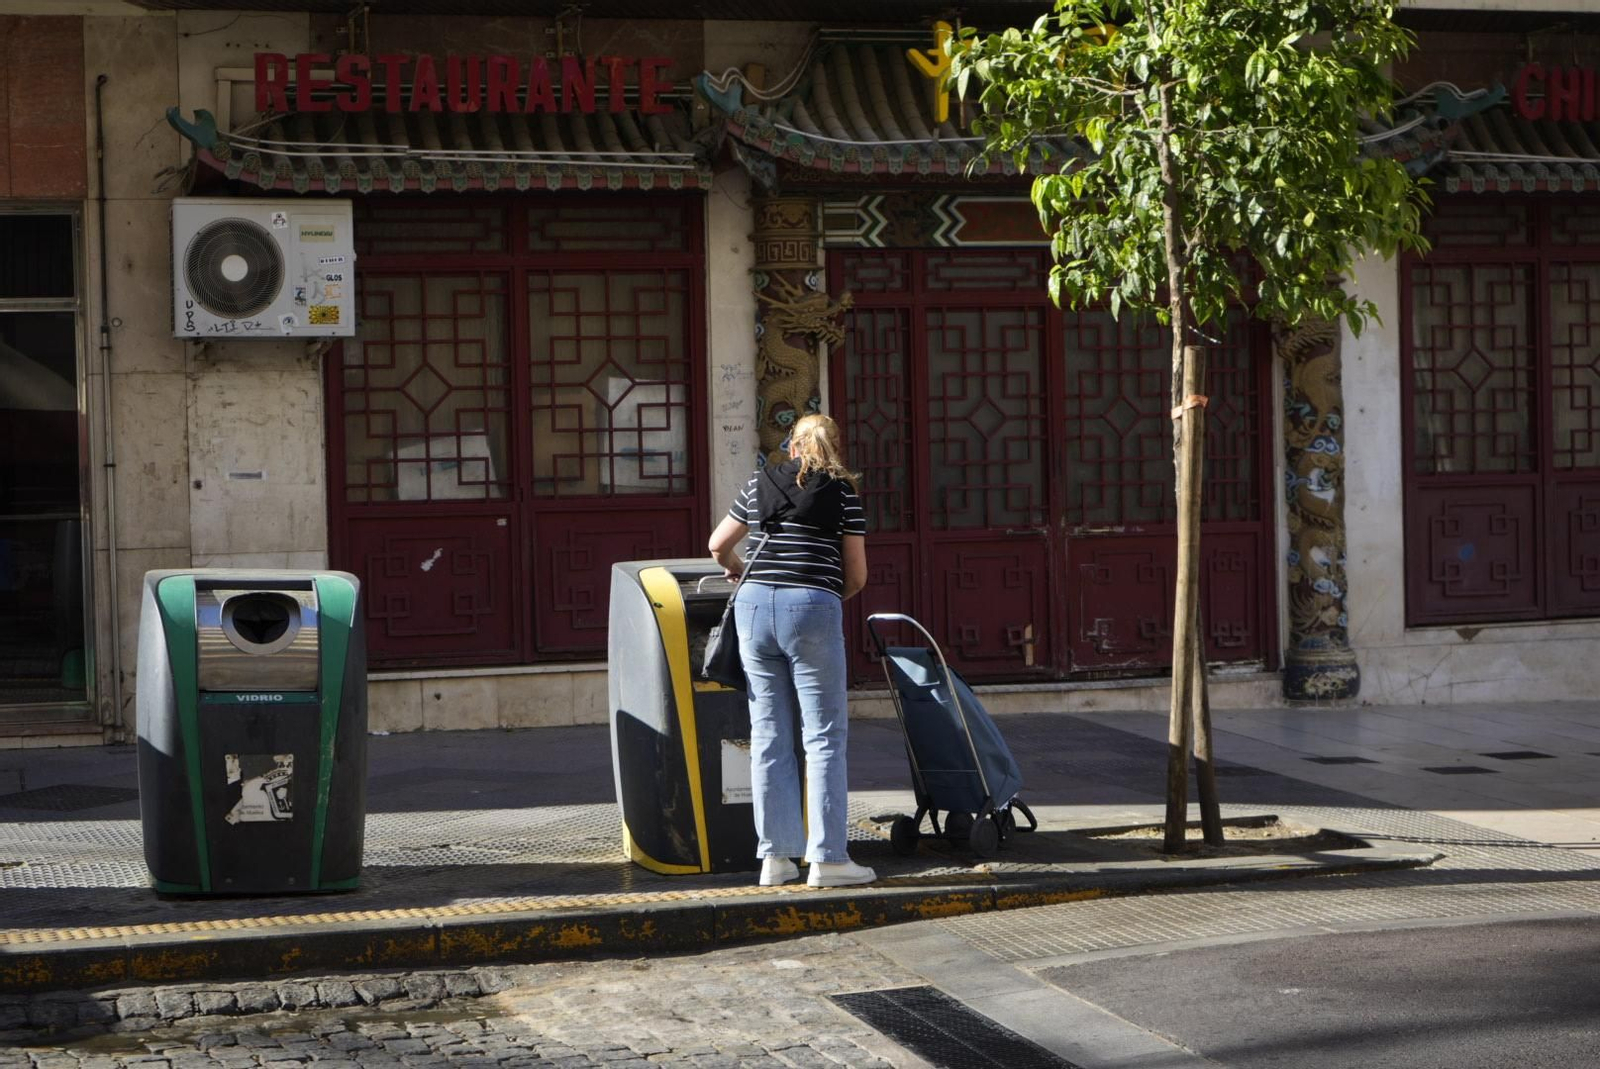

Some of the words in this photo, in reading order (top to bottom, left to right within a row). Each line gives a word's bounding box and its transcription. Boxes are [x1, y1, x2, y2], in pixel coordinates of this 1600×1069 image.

[254, 53, 674, 115] RESTAURANTE
[325, 274, 343, 282] GLOS
[235, 694, 284, 702] VIDRIO
